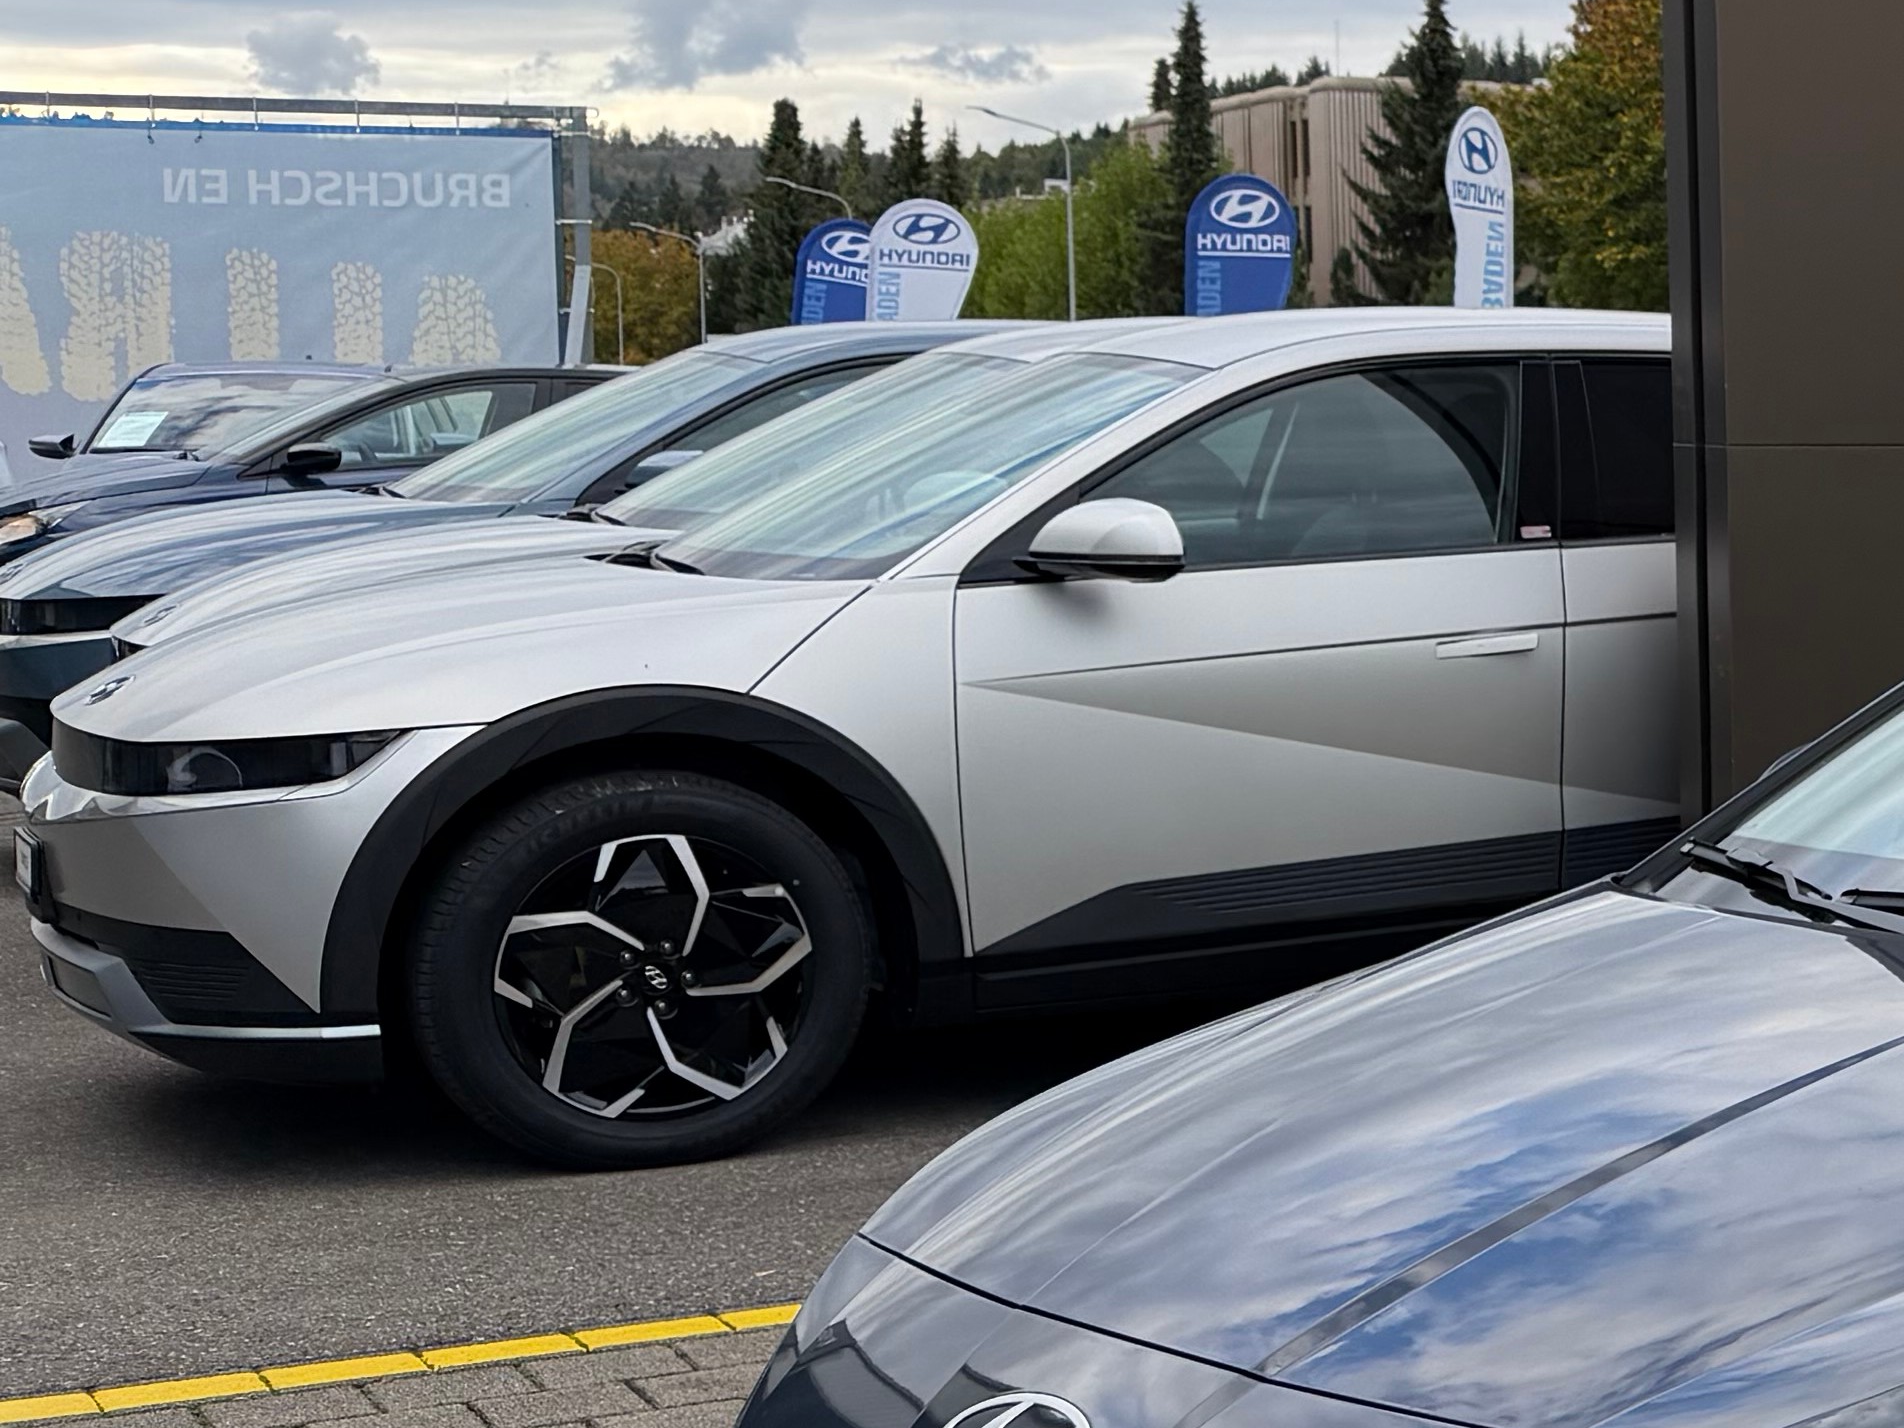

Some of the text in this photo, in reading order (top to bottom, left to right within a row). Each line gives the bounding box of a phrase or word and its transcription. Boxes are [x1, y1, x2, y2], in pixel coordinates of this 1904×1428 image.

[1197, 233, 1291, 251] HYUNDAI
[879, 248, 971, 267] HYUNDAI
[806, 259, 868, 282] HYUN
